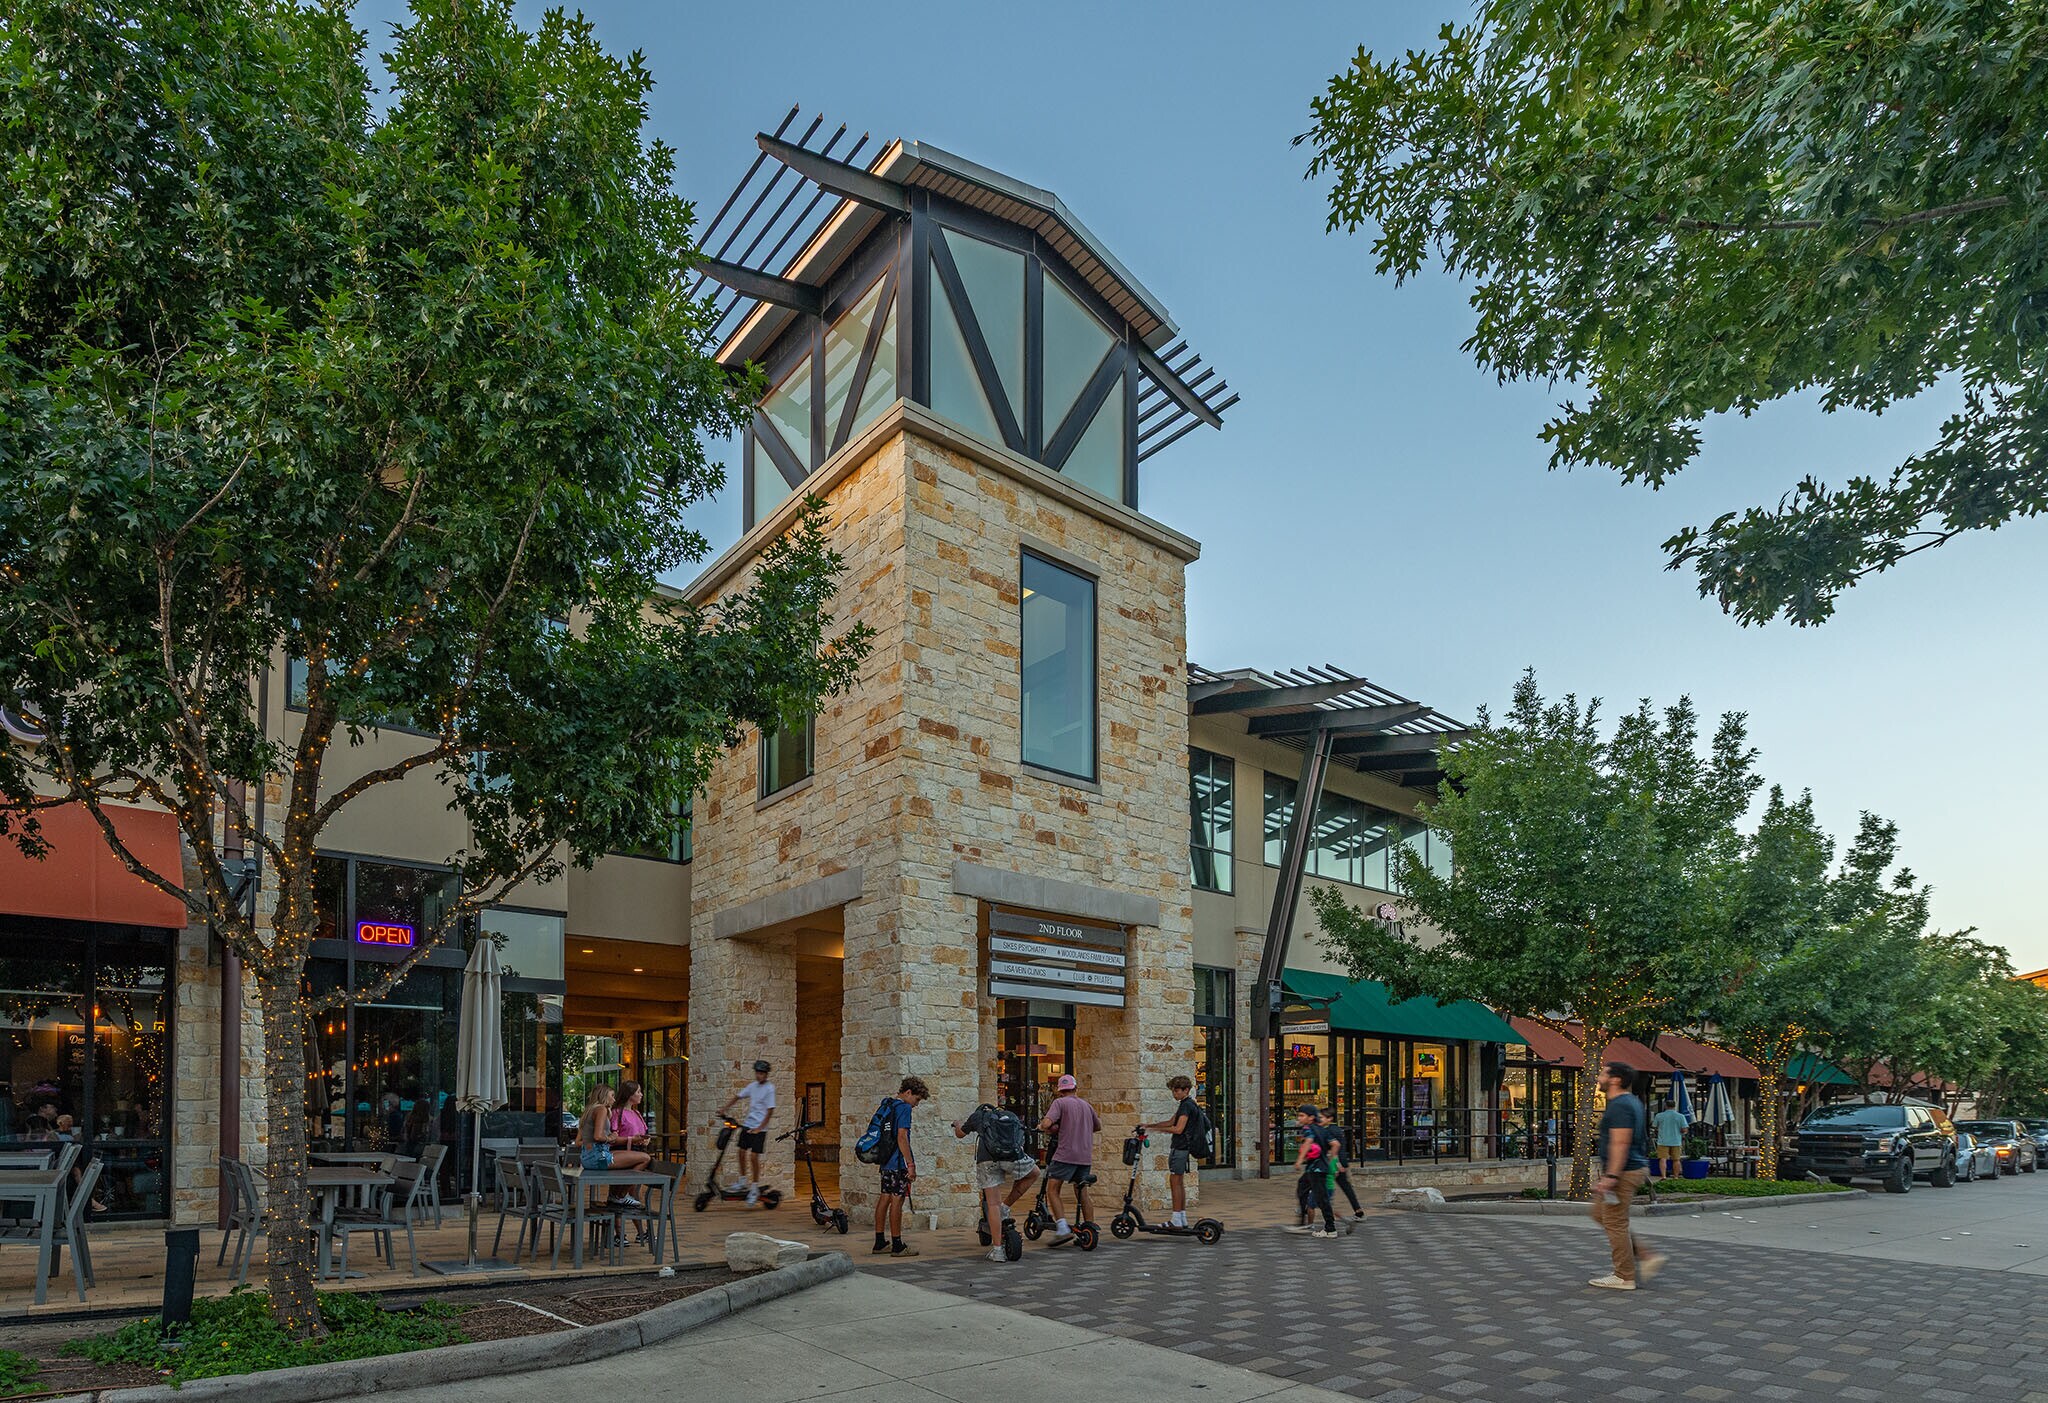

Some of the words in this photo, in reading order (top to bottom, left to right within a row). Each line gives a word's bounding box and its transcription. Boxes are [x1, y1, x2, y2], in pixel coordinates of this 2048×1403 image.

[360, 925, 410, 945] OPEN
[1038, 923, 1056, 935] 2ND
[1056, 926, 1083, 939] FLOOR
[1002, 942, 1018, 951] SIKES
[1018, 943, 1048, 954] PSYCHIATRY
[1061, 949, 1090, 960] WOODLANDS
[1090, 952, 1105, 962] FAMILY
[1105, 954, 1122, 965] DENTAL
[1004, 965, 1014, 973] USA
[1014, 966, 1027, 975] VEIN
[1027, 967, 1047, 977] CLINICS
[1072, 972, 1086, 981] CLUB
[1093, 975, 1113, 985] PILATES
